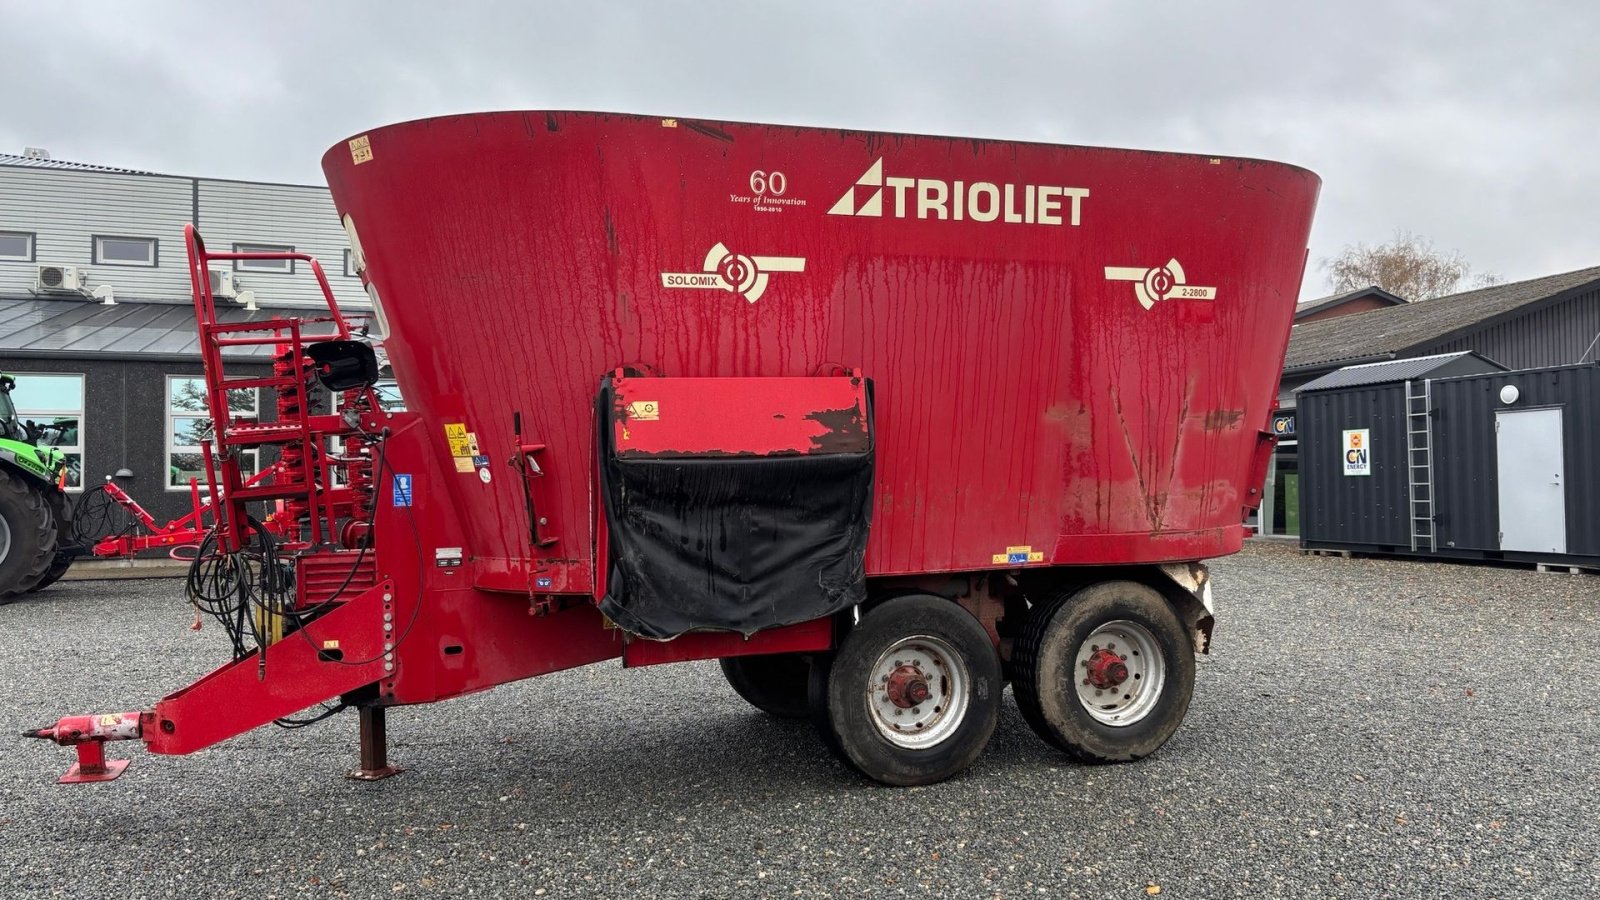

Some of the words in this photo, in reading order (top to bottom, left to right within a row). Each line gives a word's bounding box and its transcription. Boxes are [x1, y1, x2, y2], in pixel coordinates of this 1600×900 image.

[750, 170, 787, 196] 60
[730, 194, 751, 203] Years
[753, 195, 762, 207] of
[763, 196, 807, 206] Innovation
[886, 177, 1090, 226] TRIOLIET
[667, 275, 718, 286] SOLOMIX
[1182, 288, 1208, 297] 2-2800
[1274, 416, 1295, 434] CN
[1346, 448, 1367, 464] CN
